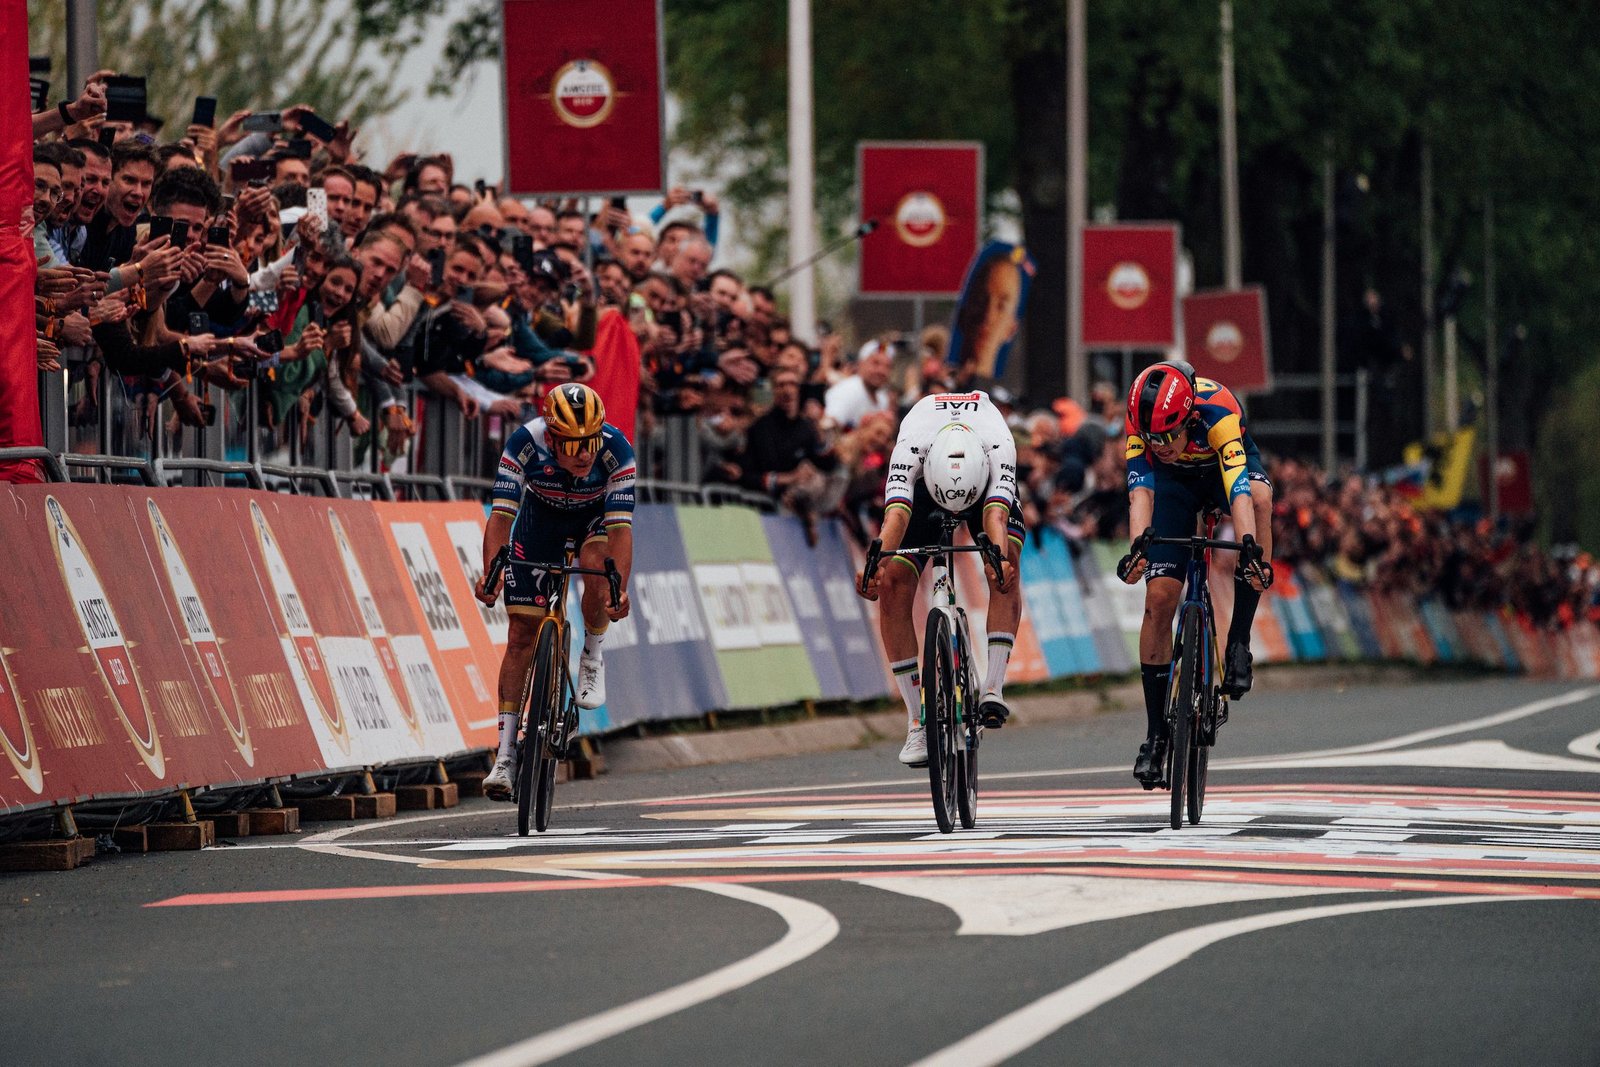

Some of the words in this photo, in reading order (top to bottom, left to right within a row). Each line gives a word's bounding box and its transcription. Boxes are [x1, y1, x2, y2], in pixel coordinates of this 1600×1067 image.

[1162, 377, 1179, 410] TREK
[935, 401, 978, 411] UAE
[945, 489, 966, 500] G42
[79, 599, 118, 640] AMSTEL
